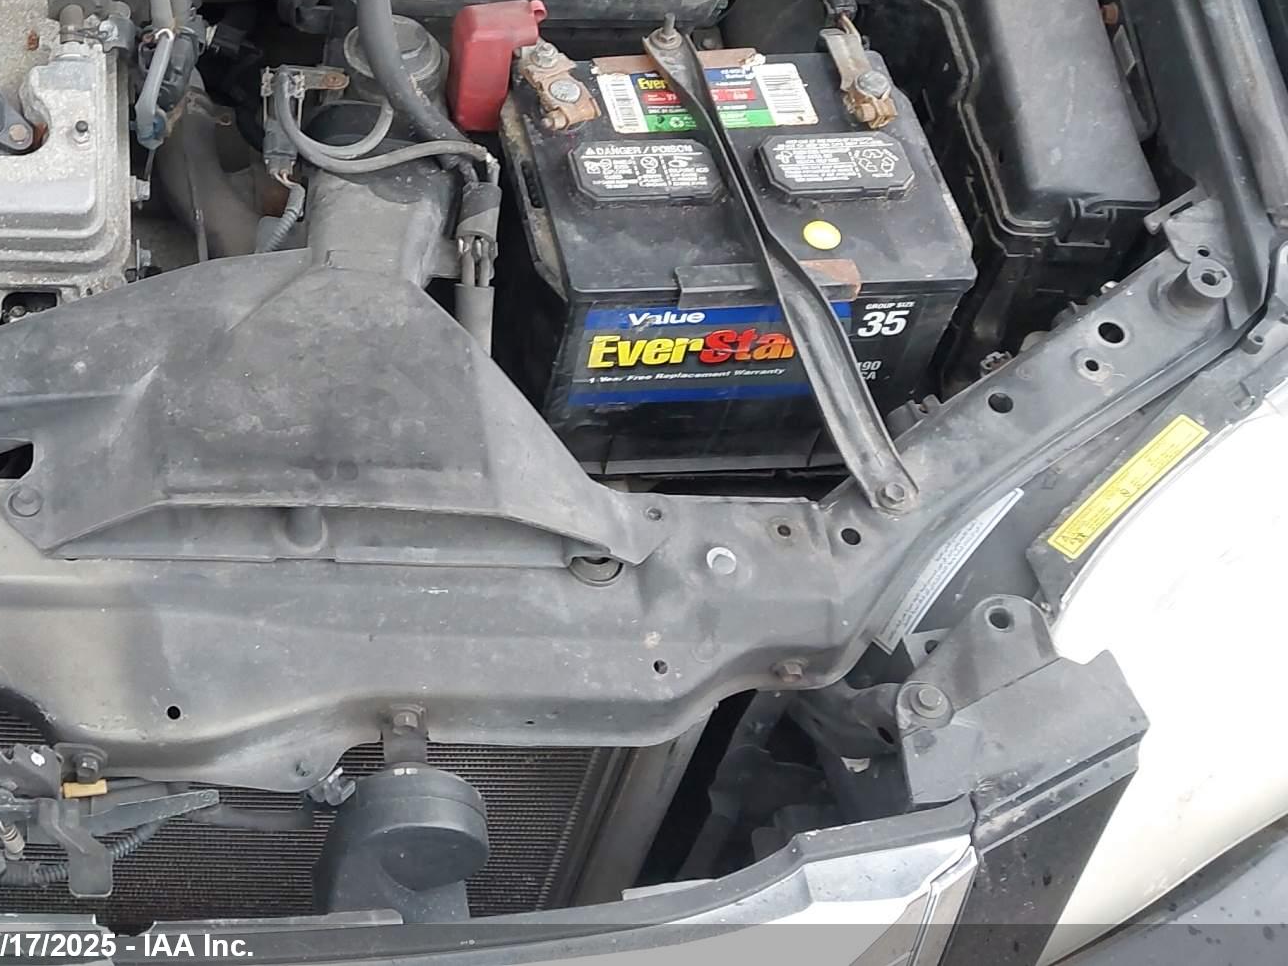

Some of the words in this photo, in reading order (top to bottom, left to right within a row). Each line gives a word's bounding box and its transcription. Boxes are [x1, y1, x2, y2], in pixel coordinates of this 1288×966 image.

[596, 145, 640, 155] DANGER
[651, 144, 694, 153] POISON
[865, 302, 896, 310] GROUP
[628, 312, 706, 326] Value
[857, 310, 910, 337] 35
[655, 368, 732, 380] Replacement
[734, 367, 787, 376] Warranty
